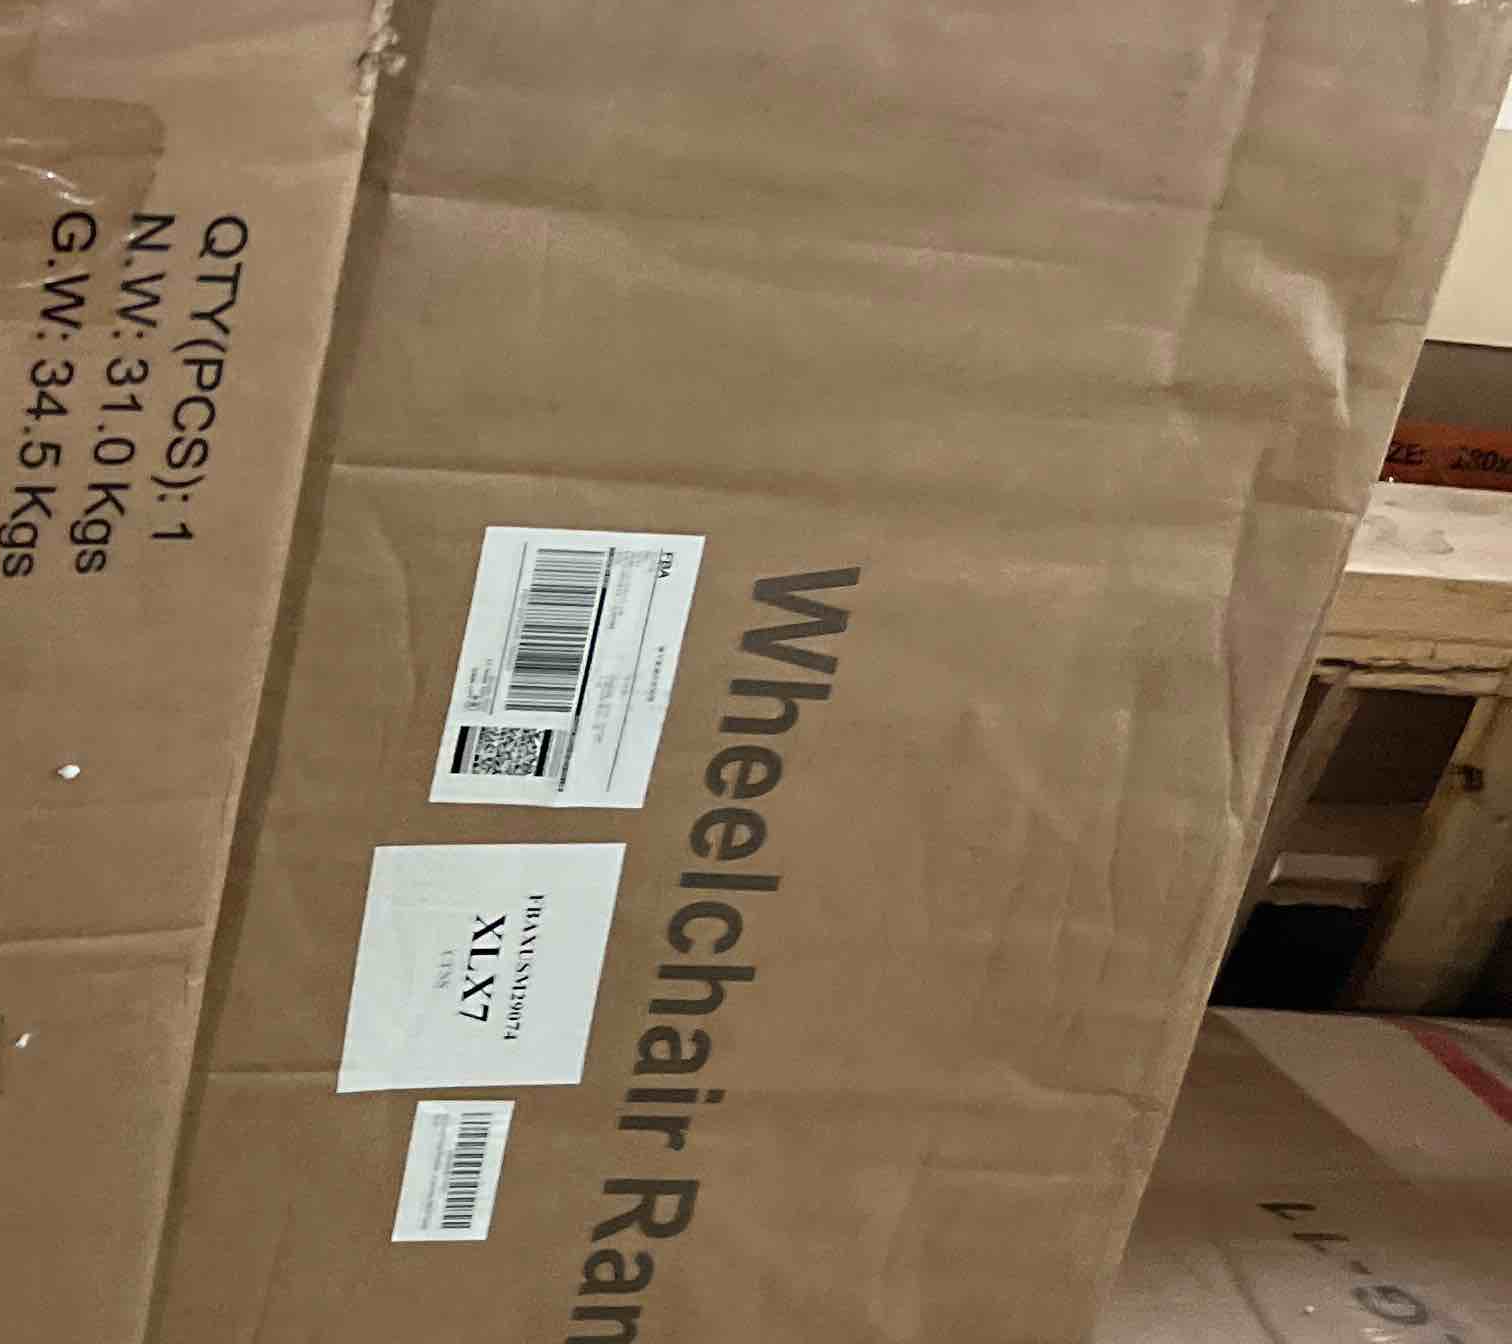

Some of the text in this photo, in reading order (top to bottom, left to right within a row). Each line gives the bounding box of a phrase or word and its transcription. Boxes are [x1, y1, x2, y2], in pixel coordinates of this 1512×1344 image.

[36, 210, 98, 341] G.W:
[150, 215, 249, 541] QTY(PCS): 1
[17, 358, 75, 470] 34.5
[69, 212, 177, 575] N.W: 31.0 Kgs
[458, 913, 507, 1023] XLX7
[617, 564, 862, 1154] Wheelchair
